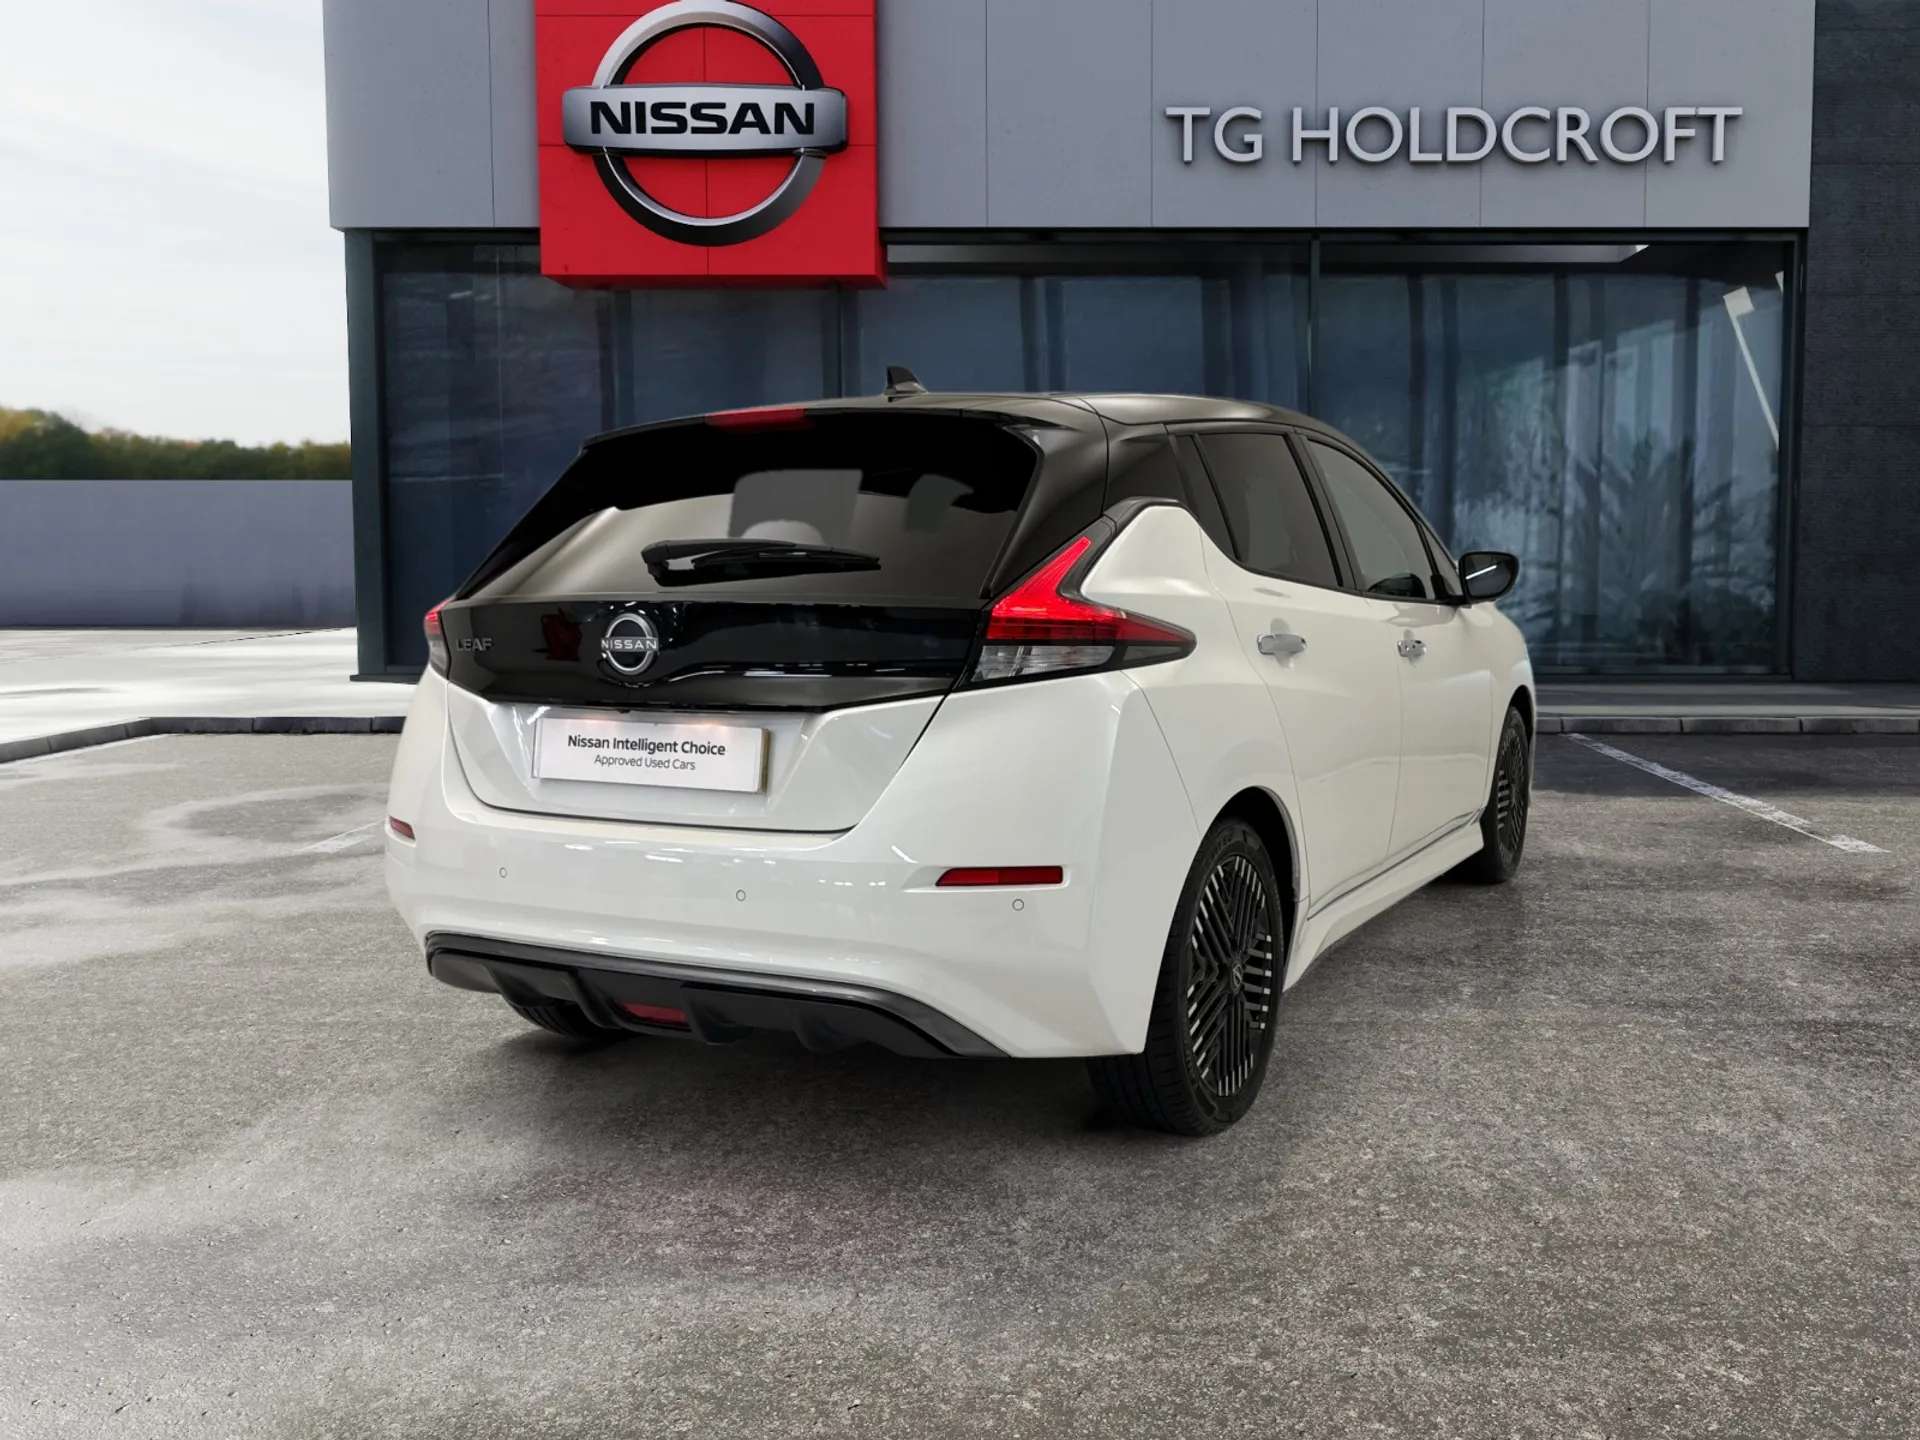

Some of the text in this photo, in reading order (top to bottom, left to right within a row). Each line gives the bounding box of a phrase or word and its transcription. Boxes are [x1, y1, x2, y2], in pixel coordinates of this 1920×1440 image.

[590, 101, 815, 135] NISSAN
[1166, 106, 1743, 163] TG HOLDCROFT
[455, 637, 493, 651] LEAF
[601, 637, 657, 650] NISSAN
[567, 734, 726, 756] Nissan Intelligent Choice
[594, 754, 696, 771] Approved Used Cars
